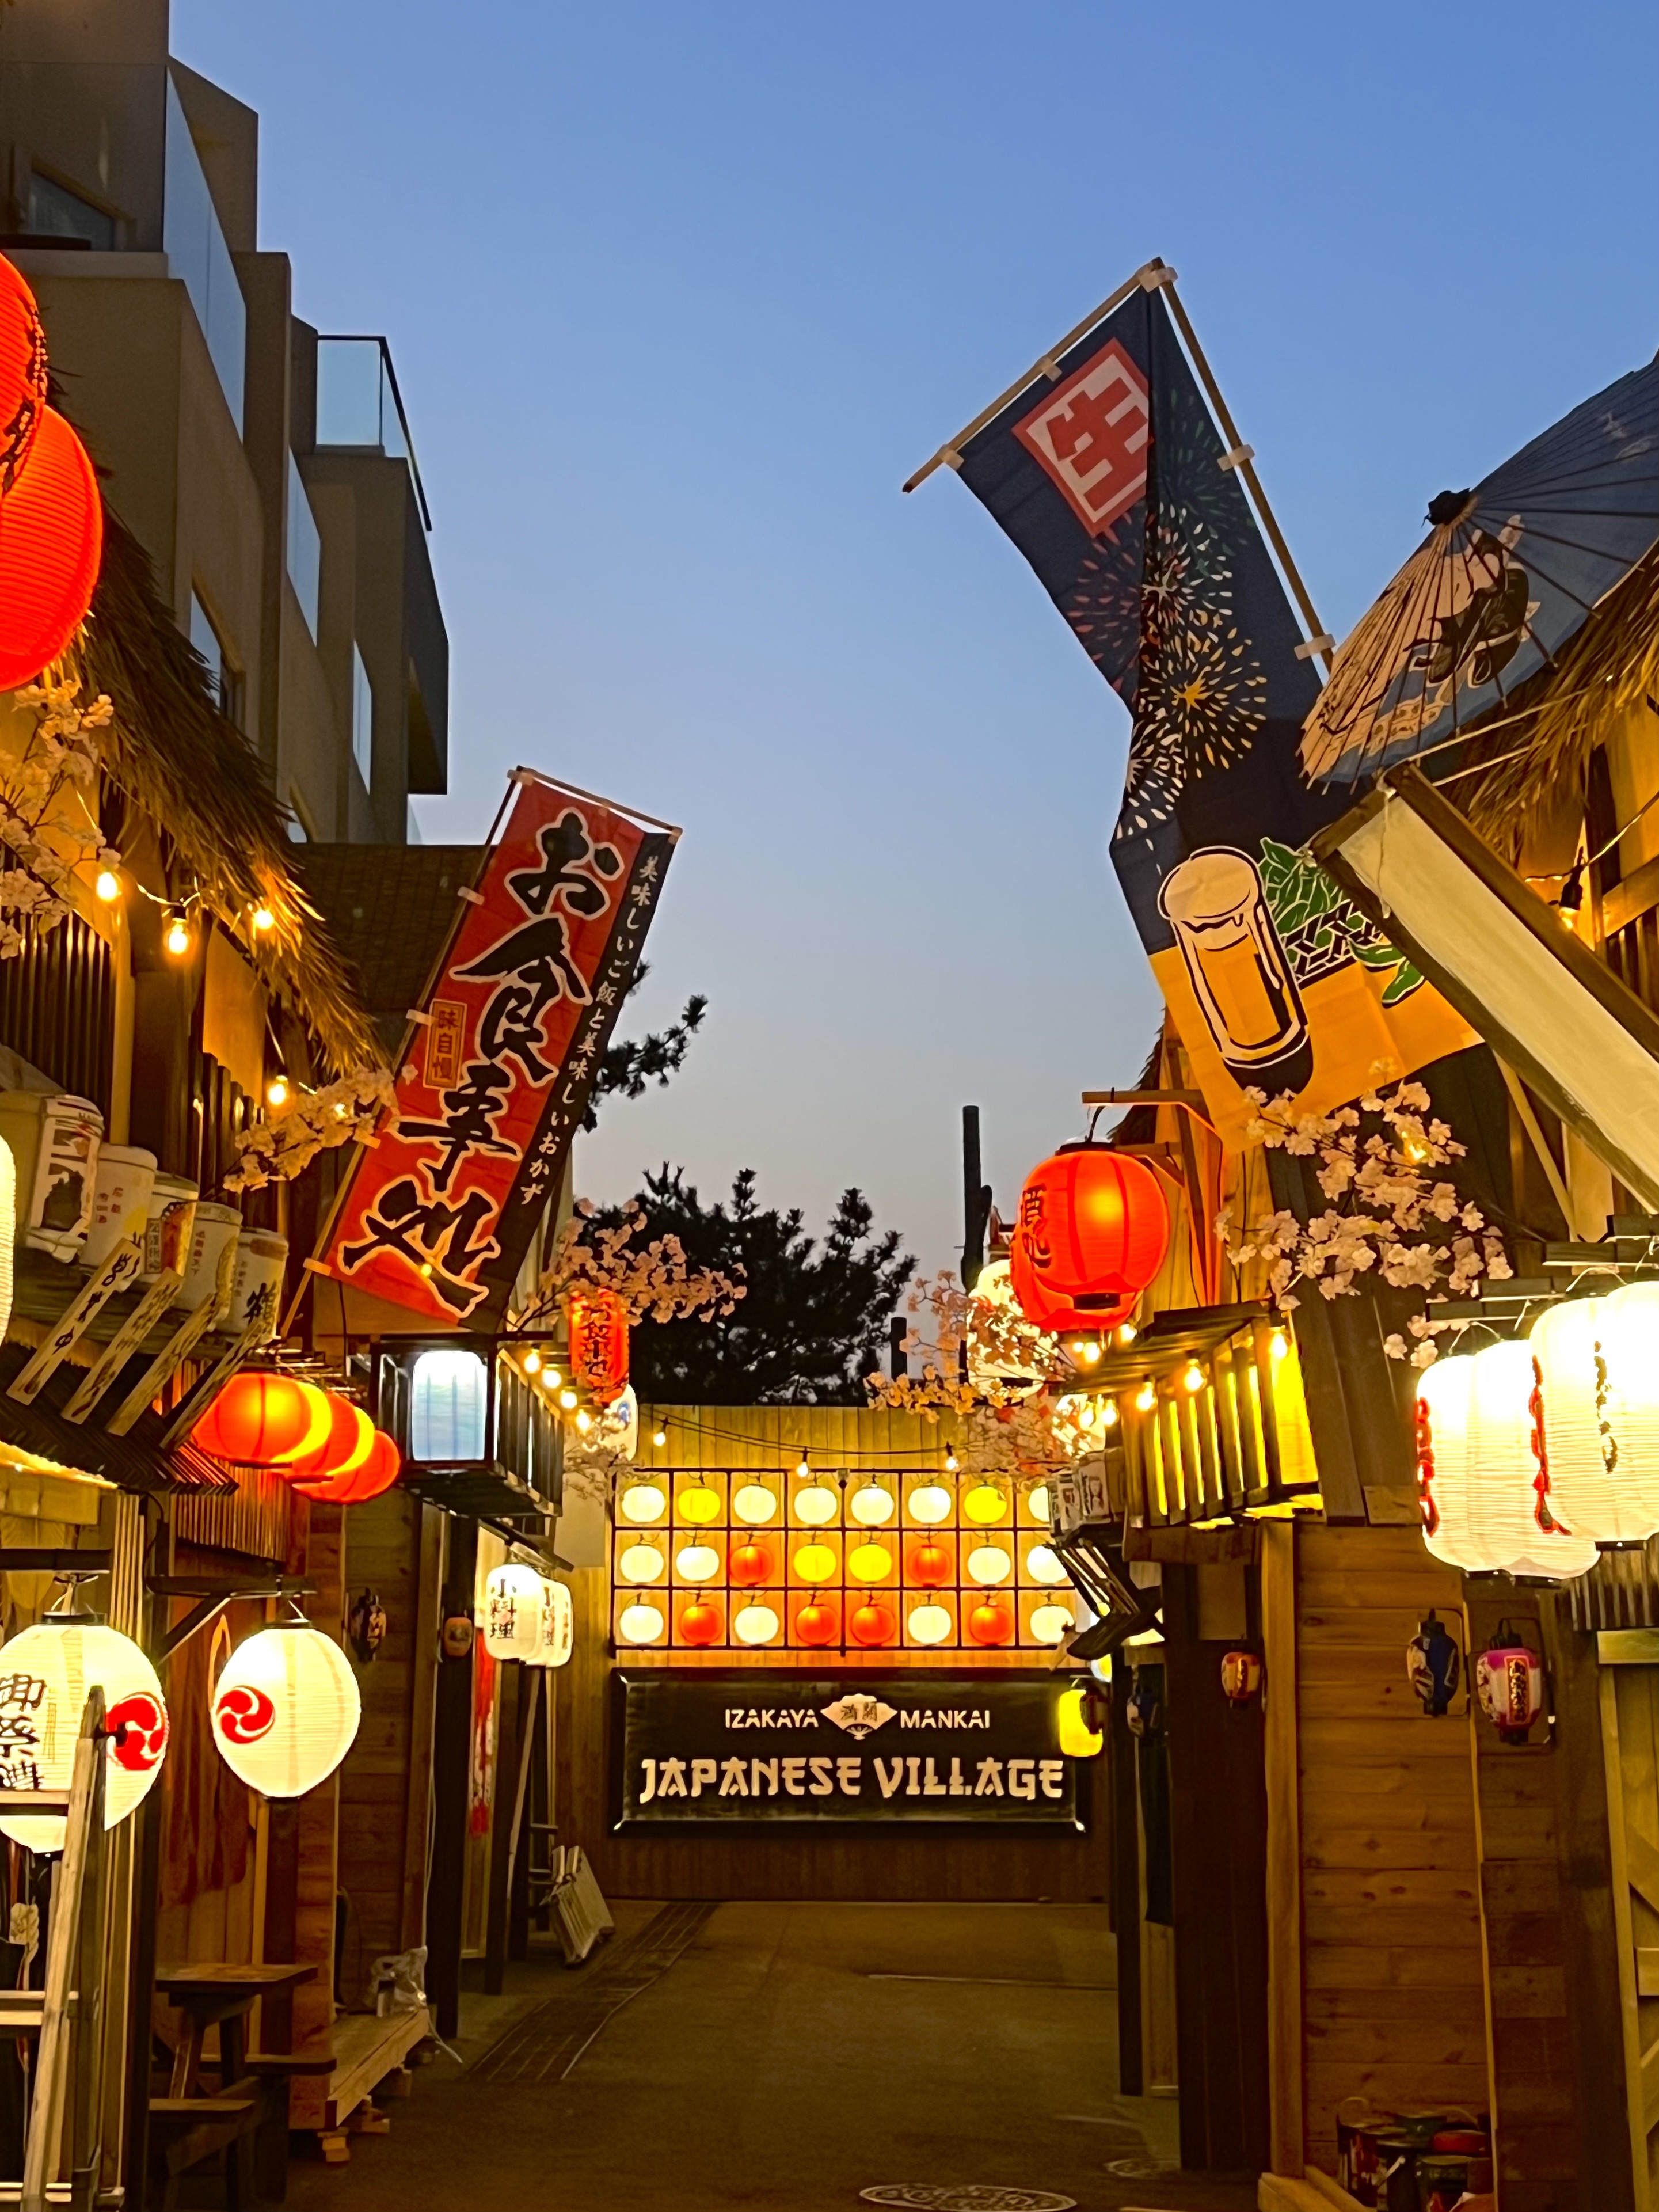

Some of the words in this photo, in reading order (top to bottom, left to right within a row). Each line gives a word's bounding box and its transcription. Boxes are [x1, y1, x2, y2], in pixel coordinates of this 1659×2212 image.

[1046, 377, 1148, 512] 生
[338, 807, 624, 1317] お食事処
[520, 856, 659, 1205] 美味しいご飯と美味しいおかず
[640, 1757, 861, 1804] JAPANESE
[873, 1757, 1063, 1800] VILLAGE
[725, 1709, 819, 1728] IZAKAYA
[900, 1709, 990, 1728] MANKAI
